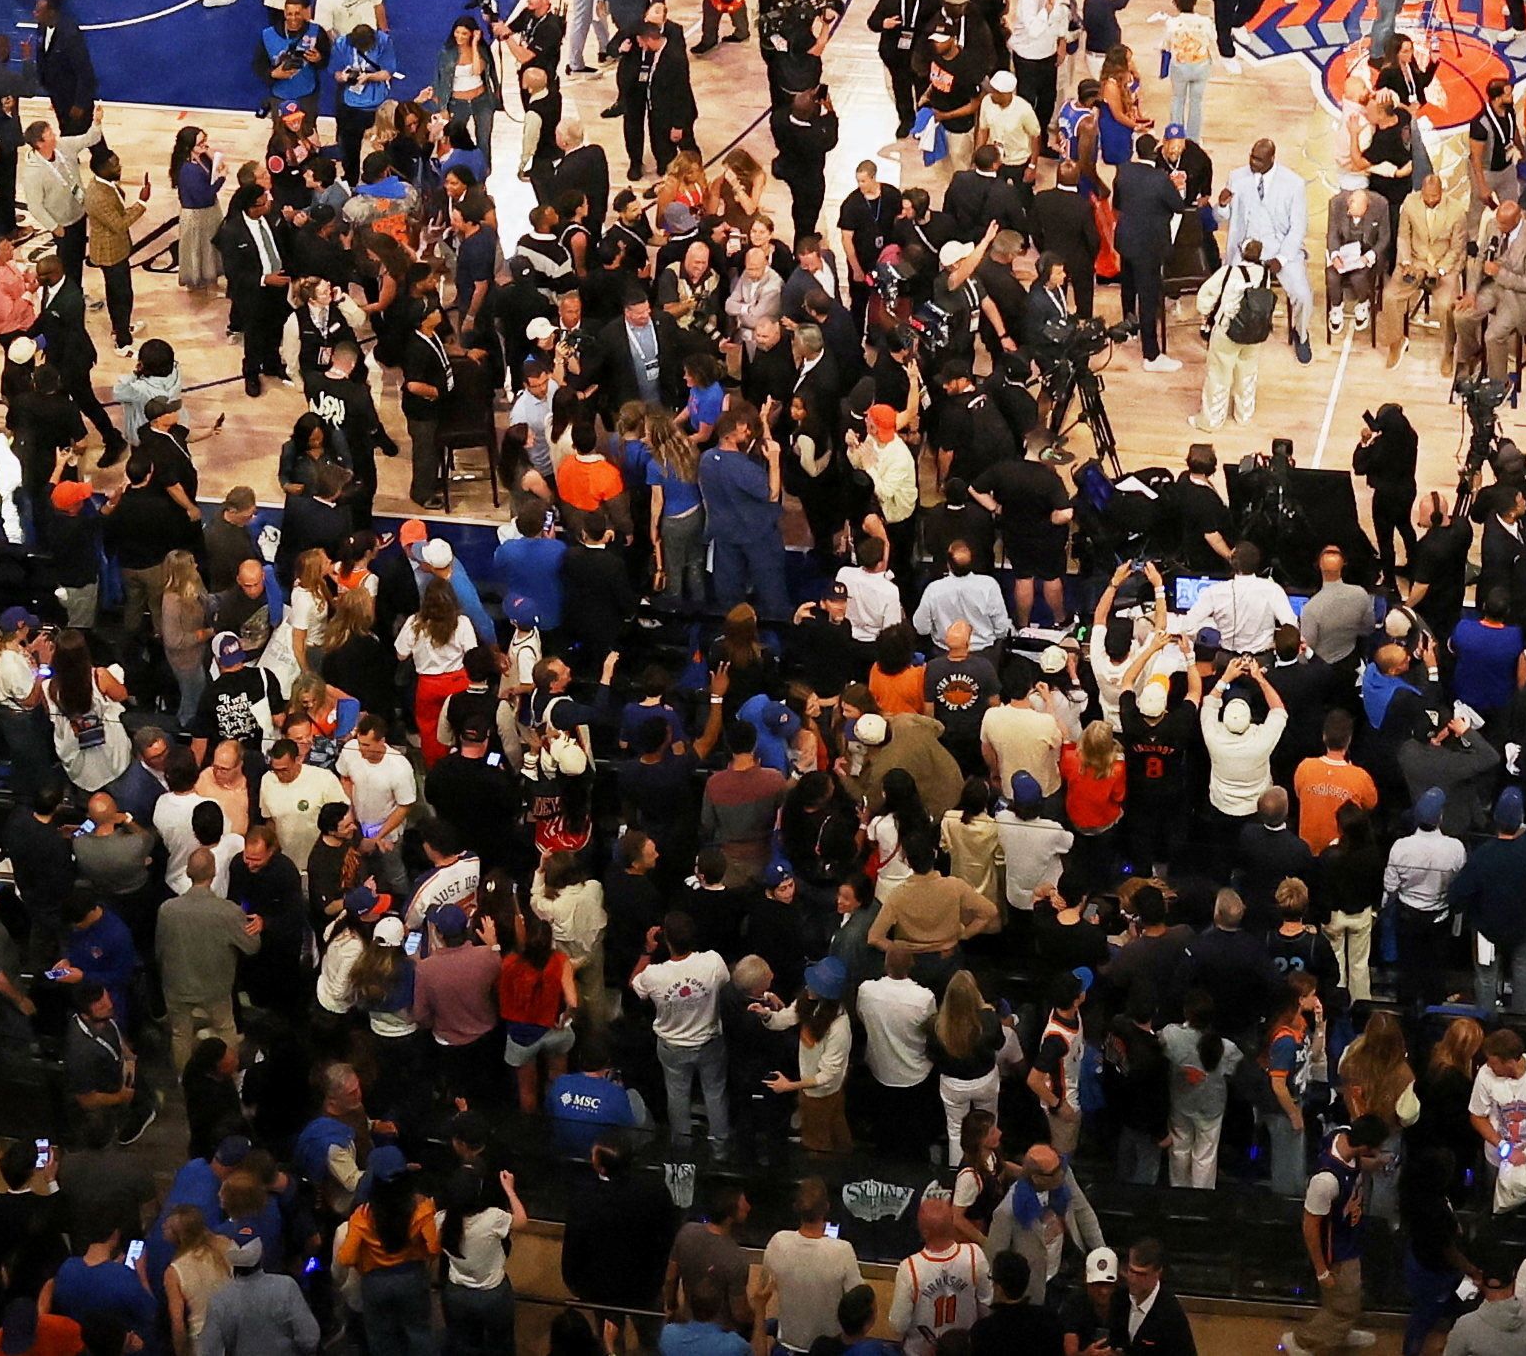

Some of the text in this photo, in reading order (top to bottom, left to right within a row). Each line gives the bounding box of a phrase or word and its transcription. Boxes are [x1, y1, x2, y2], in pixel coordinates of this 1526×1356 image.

[1145, 756, 1165, 779] 8
[434, 883, 461, 906] JUST
[573, 1094, 601, 1108] MSC
[933, 1294, 957, 1328] 11
